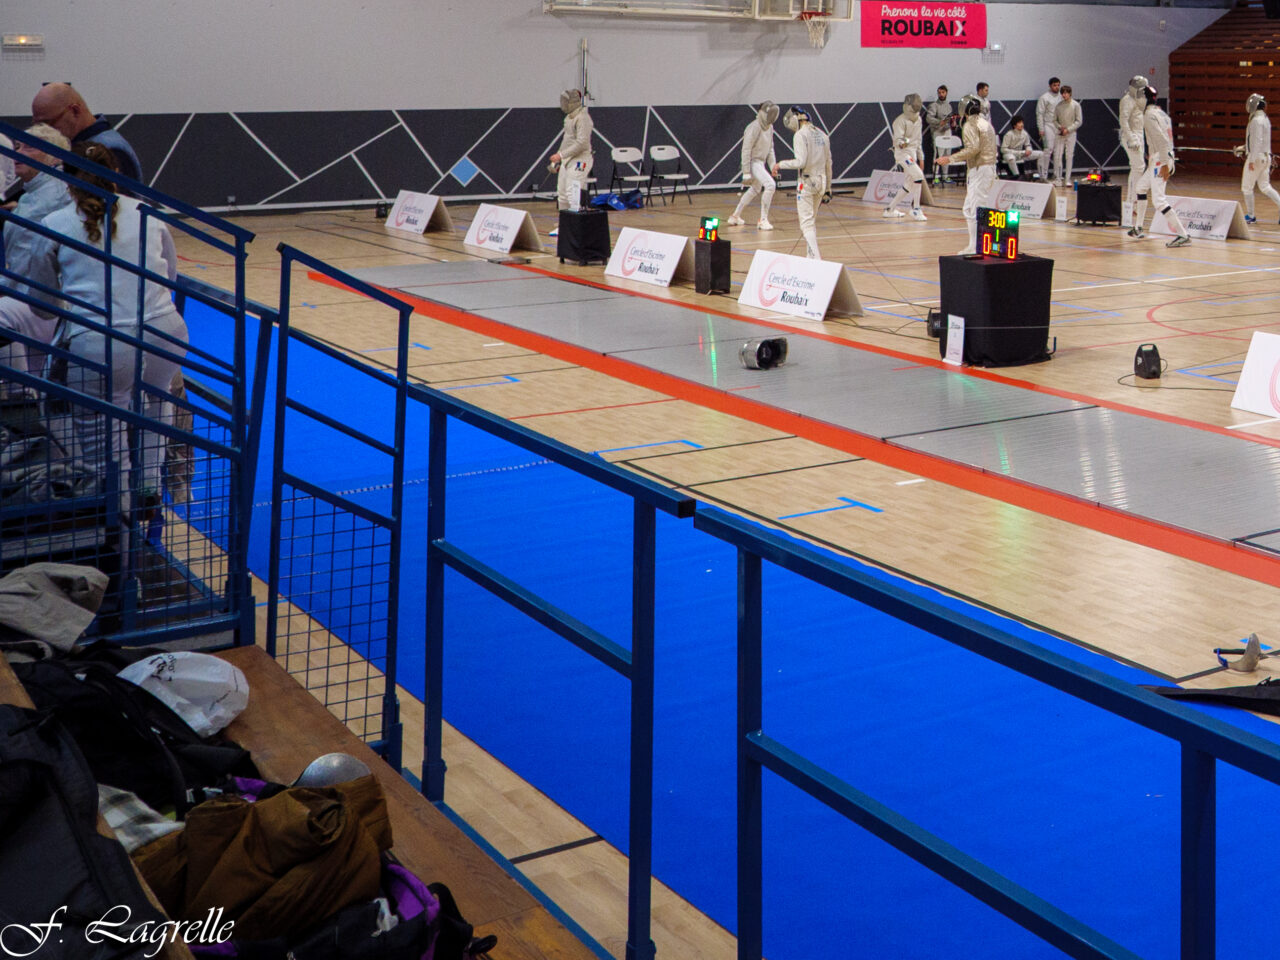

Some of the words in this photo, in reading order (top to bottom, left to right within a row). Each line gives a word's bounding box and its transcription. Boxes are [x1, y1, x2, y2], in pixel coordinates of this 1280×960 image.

[881, 4, 918, 17] Prenons
[921, 5, 933, 17] la
[934, 7, 946, 18] vie
[947, 6, 967, 18] côté
[881, 19, 967, 37] ROUBAIX
[988, 210, 1006, 228] 3:00
[1187, 221, 1213, 231] Roubaix
[983, 233, 991, 254] 0
[1007, 237, 1016, 259] 0
[768, 272, 786, 285] Cercle
[780, 290, 809, 306] Roubaix
